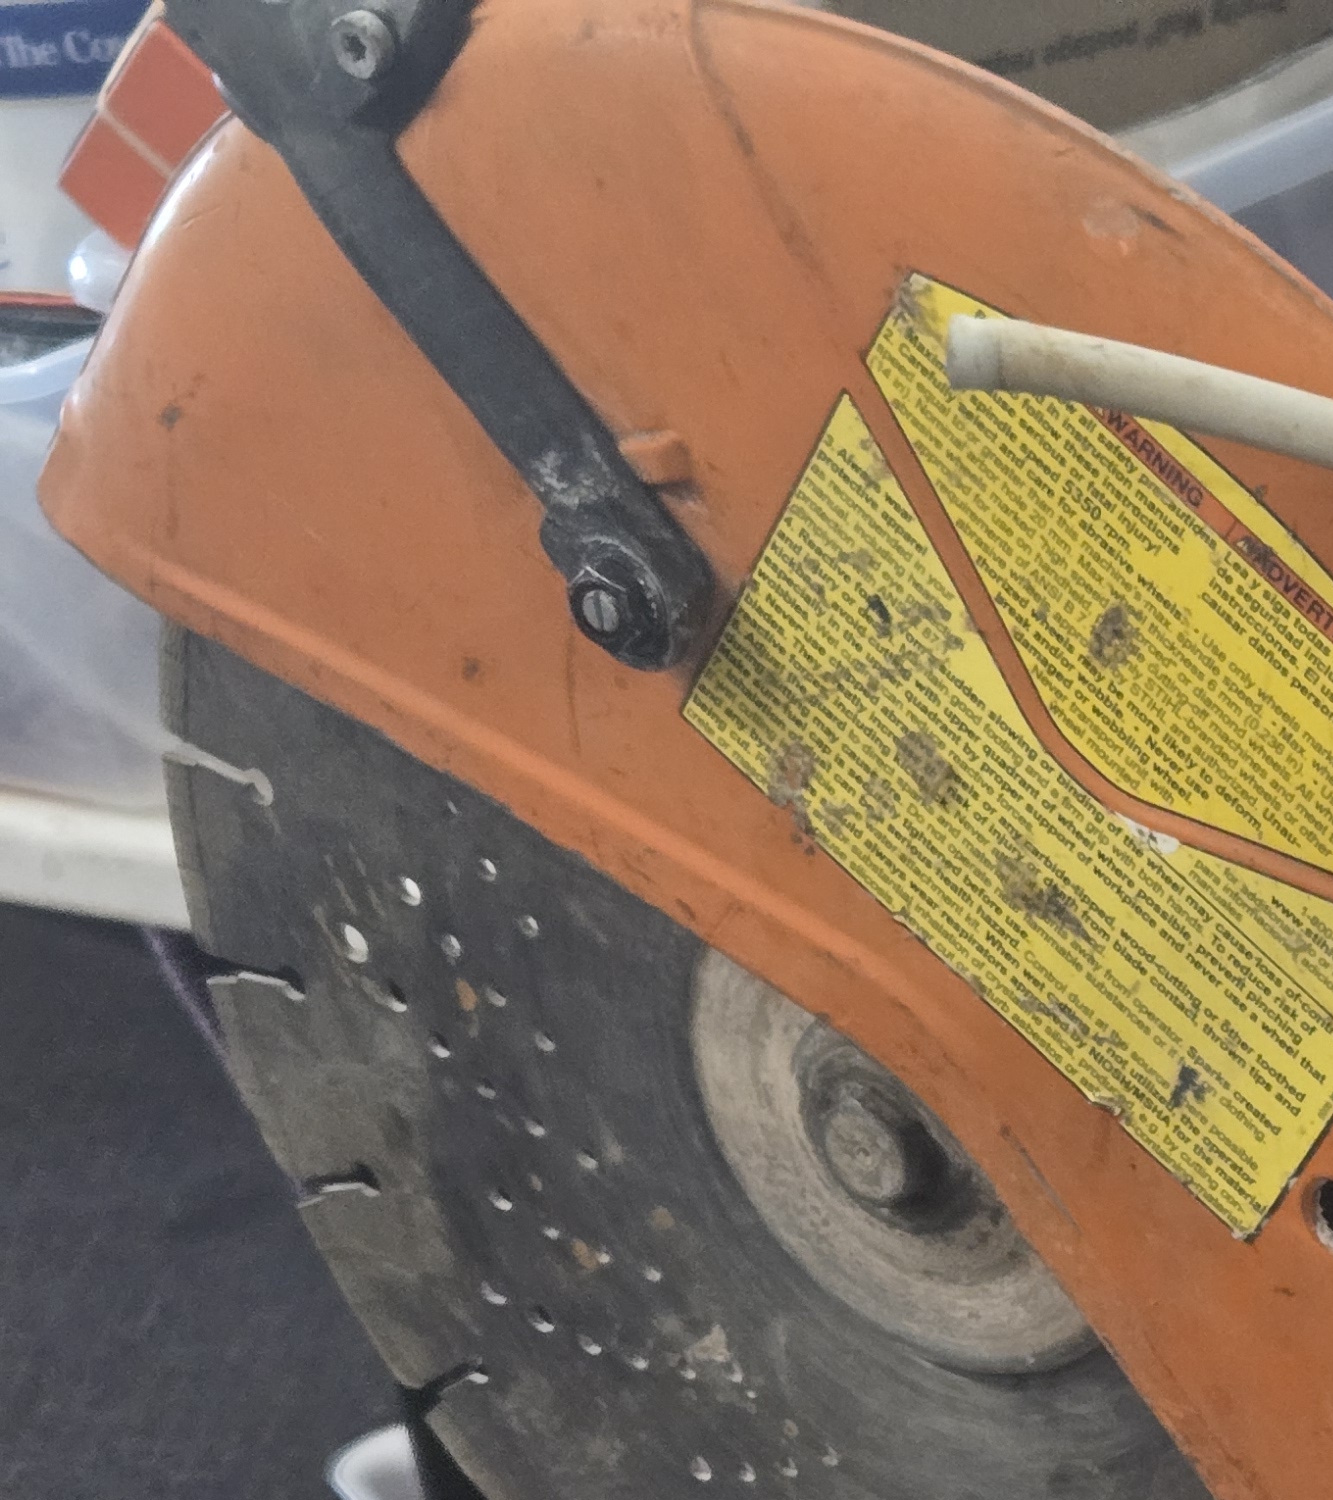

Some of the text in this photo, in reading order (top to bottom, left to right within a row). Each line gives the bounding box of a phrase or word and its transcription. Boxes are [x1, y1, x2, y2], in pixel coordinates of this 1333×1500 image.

[966, 390, 1104, 523] spindle speed 5350
[1016, 415, 1070, 469] serious
[1067, 466, 1085, 484] or
[1084, 480, 1117, 514] fatal
[1019, 397, 1183, 556] follow these instructions
[1061, 416, 1135, 490] instruction
[1077, 412, 1097, 434] all
[1093, 430, 1139, 477] safety
[1102, 406, 1206, 509] WARNING
[893, 341, 957, 405] Carefully
[955, 399, 999, 443] select
[998, 440, 1027, 470] and
[1024, 468, 1056, 499] care
[1055, 495, 1078, 520] for
[1076, 516, 1136, 575] abrasive
[1199, 633, 1228, 663] Use
[1224, 659, 1257, 693] only
[1254, 685, 1302, 733] wheels
[1199, 591, 1246, 637] causar
[1245, 632, 1291, 678] daños
[1207, 576, 1304, 670] instrucciones.
[1302, 666, 1320, 685] El
[1214, 563, 1236, 586] de
[1232, 581, 1304, 653] seguridad
[1222, 550, 1251, 580] Lea
[1248, 578, 1261, 593] y
[1259, 586, 1293, 622] siga
[1291, 615, 1333, 657] todas
[973, 552, 1215, 786] thorized wheels may be more likely to
[1010, 628, 1074, 692] damaged
[1072, 688, 1089, 706] or
[1087, 702, 1153, 767] wobbling
[937, 661, 1254, 961] sudden slowing or binding of the wheel may cause
[1143, 734, 1210, 802] Never use
[1147, 776, 1177, 806] with
[841, 628, 1328, 1085] the quadrant by proper support of workpiece and never use a wheel that
[898, 816, 1006, 917] tightened before
[912, 676, 1305, 1047] with upper quadrant of wheel where pinching
[934, 865, 976, 907] health
[860, 835, 1216, 1167] always wear respirators NIOSH/MSHA for the
[971, 806, 989, 826] of
[1079, 908, 1114, 943] from
[1111, 937, 1150, 977] blade
[1201, 1021, 1250, 1069] thrown
[1245, 1063, 1275, 1095] tips
[1273, 1088, 1302, 1117] and
[980, 799, 1307, 1104] or any or toothed
[1208, 933, 1317, 1037] To reduce risk of
[982, 929, 1258, 1191] When wet the operator
[1183, 1044, 1233, 1094] Sparks
[1231, 1086, 1282, 1137] created
